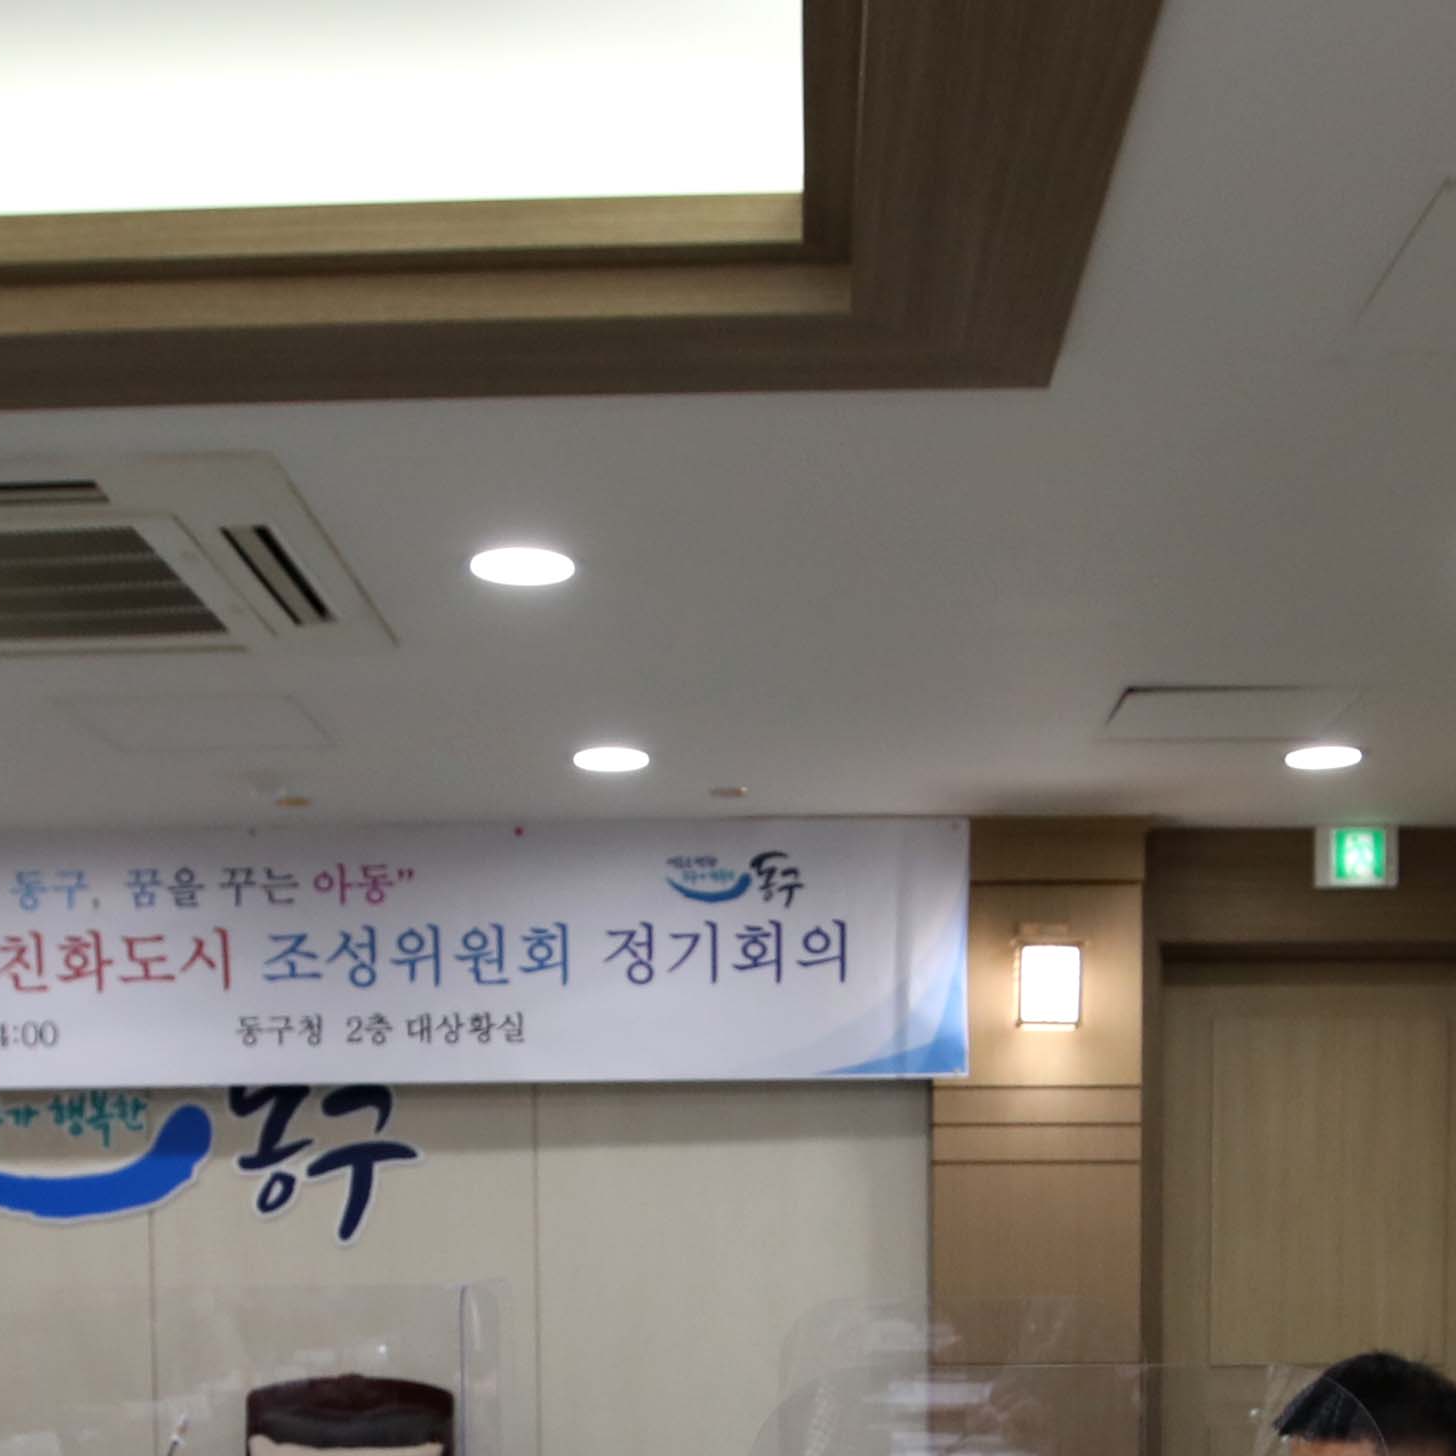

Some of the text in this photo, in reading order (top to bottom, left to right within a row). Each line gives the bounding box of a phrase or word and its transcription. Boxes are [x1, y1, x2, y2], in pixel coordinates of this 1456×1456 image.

[124, 867, 205, 908] 꿈을
[218, 865, 299, 908] 꾸는
[262, 921, 569, 989] 조성위원회
[603, 918, 848, 985] 정기회의
[236, 1015, 324, 1047] 동구청
[345, 1014, 393, 1046] 2층
[407, 1011, 526, 1046] 대상황실
[48, 1092, 147, 1149] 행복한
[227, 1084, 418, 1241] 동구
